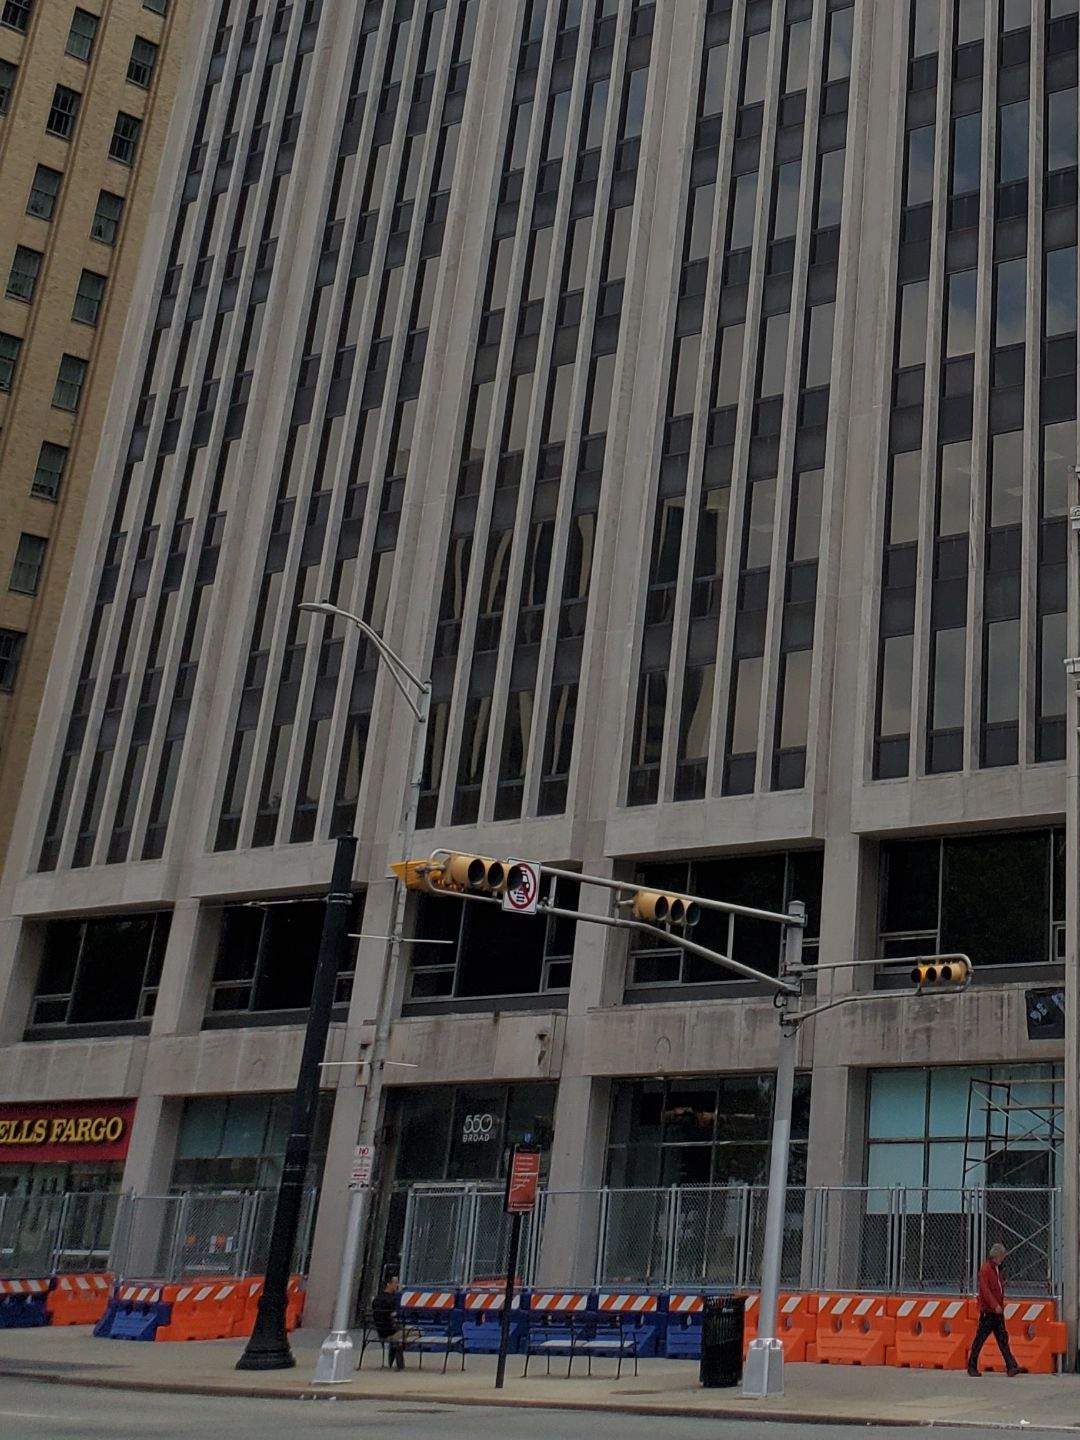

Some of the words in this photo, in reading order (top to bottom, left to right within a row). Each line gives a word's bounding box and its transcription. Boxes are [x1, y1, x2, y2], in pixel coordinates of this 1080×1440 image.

[49, 1117, 123, 1141] FARGO
[463, 1113, 493, 1134] 550
[462, 1133, 490, 1143] BROAD
